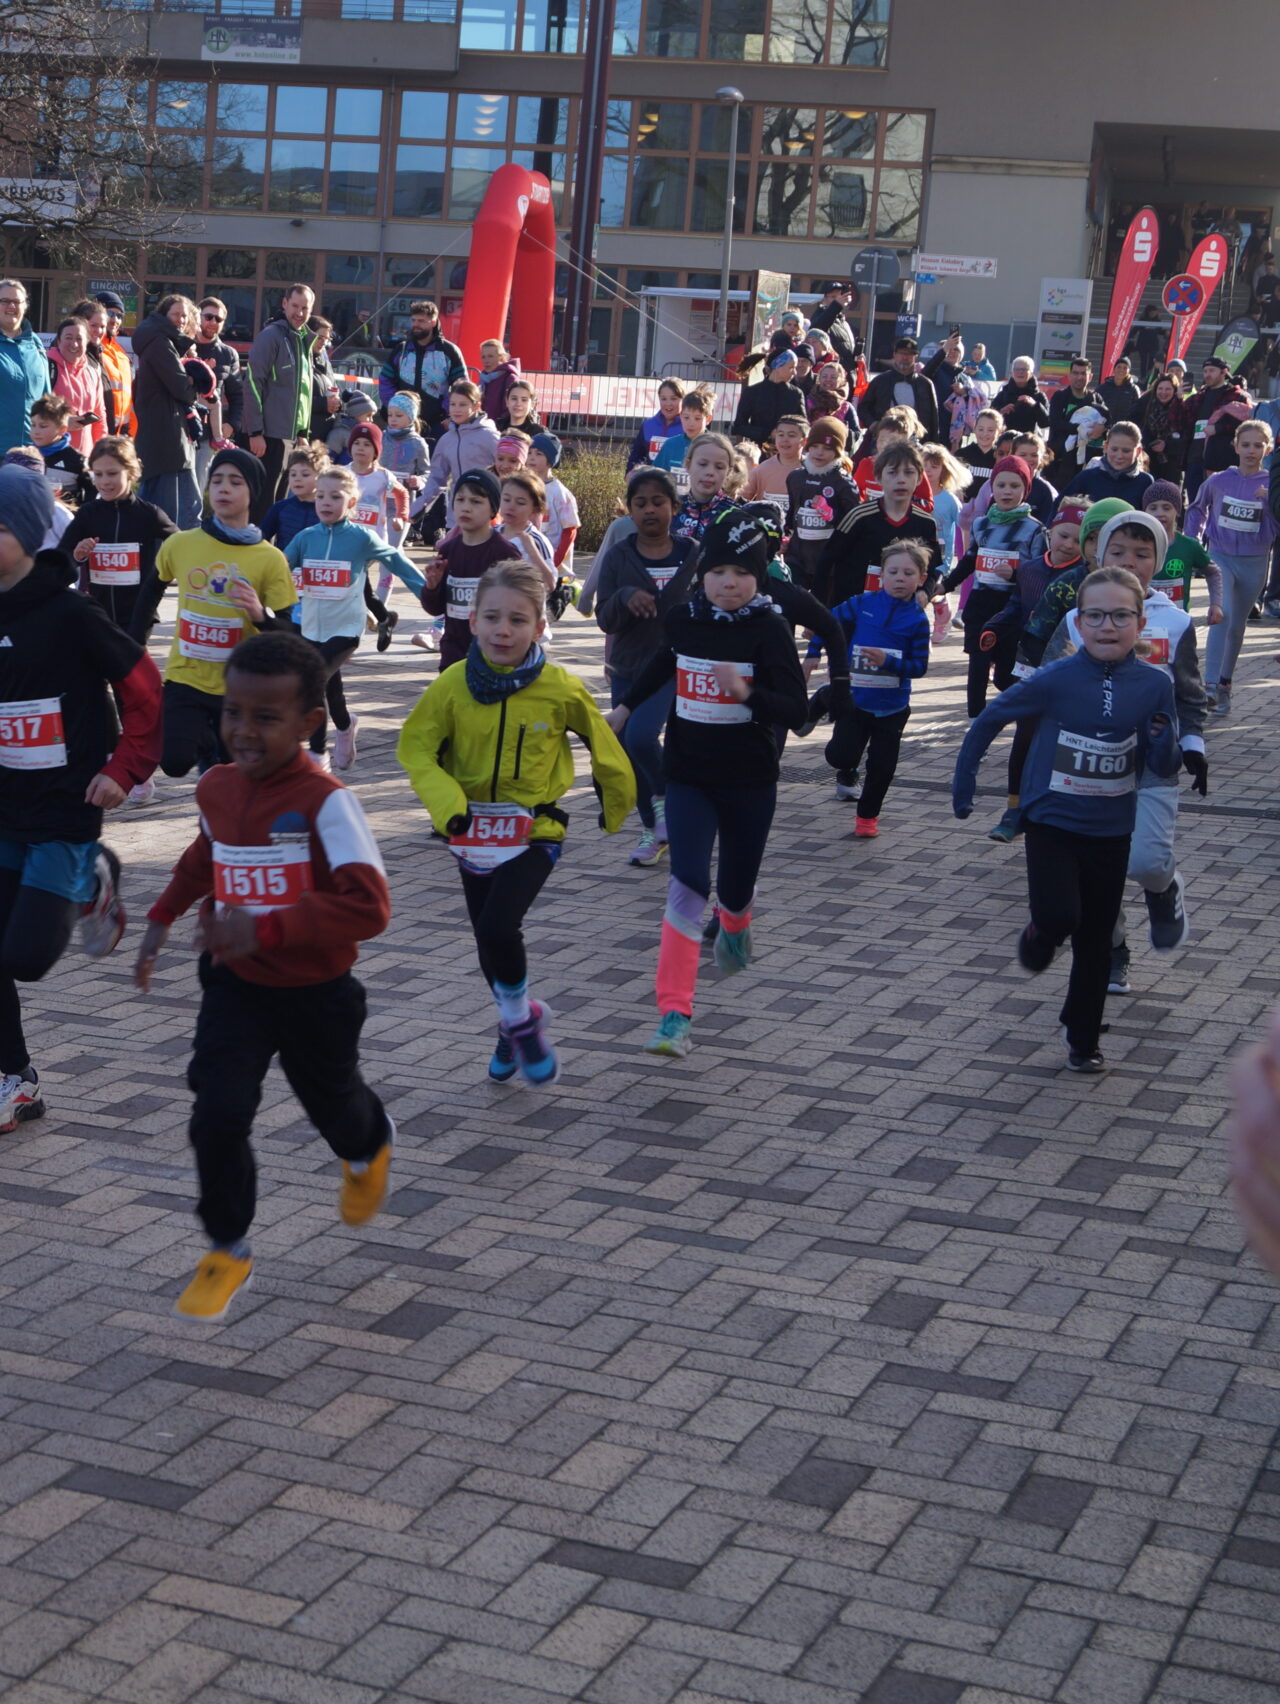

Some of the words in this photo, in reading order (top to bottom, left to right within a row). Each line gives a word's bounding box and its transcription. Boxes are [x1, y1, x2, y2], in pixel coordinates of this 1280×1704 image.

[90, 280, 132, 292] EINGANG
[1227, 505, 1255, 519] 4032
[95, 553, 129, 568] 1540
[309, 568, 338, 583] 1541
[188, 623, 229, 644] 1546
[685, 672, 732, 698] 153
[1072, 751, 1128, 774] 1160
[467, 817, 517, 840] 1544
[221, 866, 289, 896] 1515
